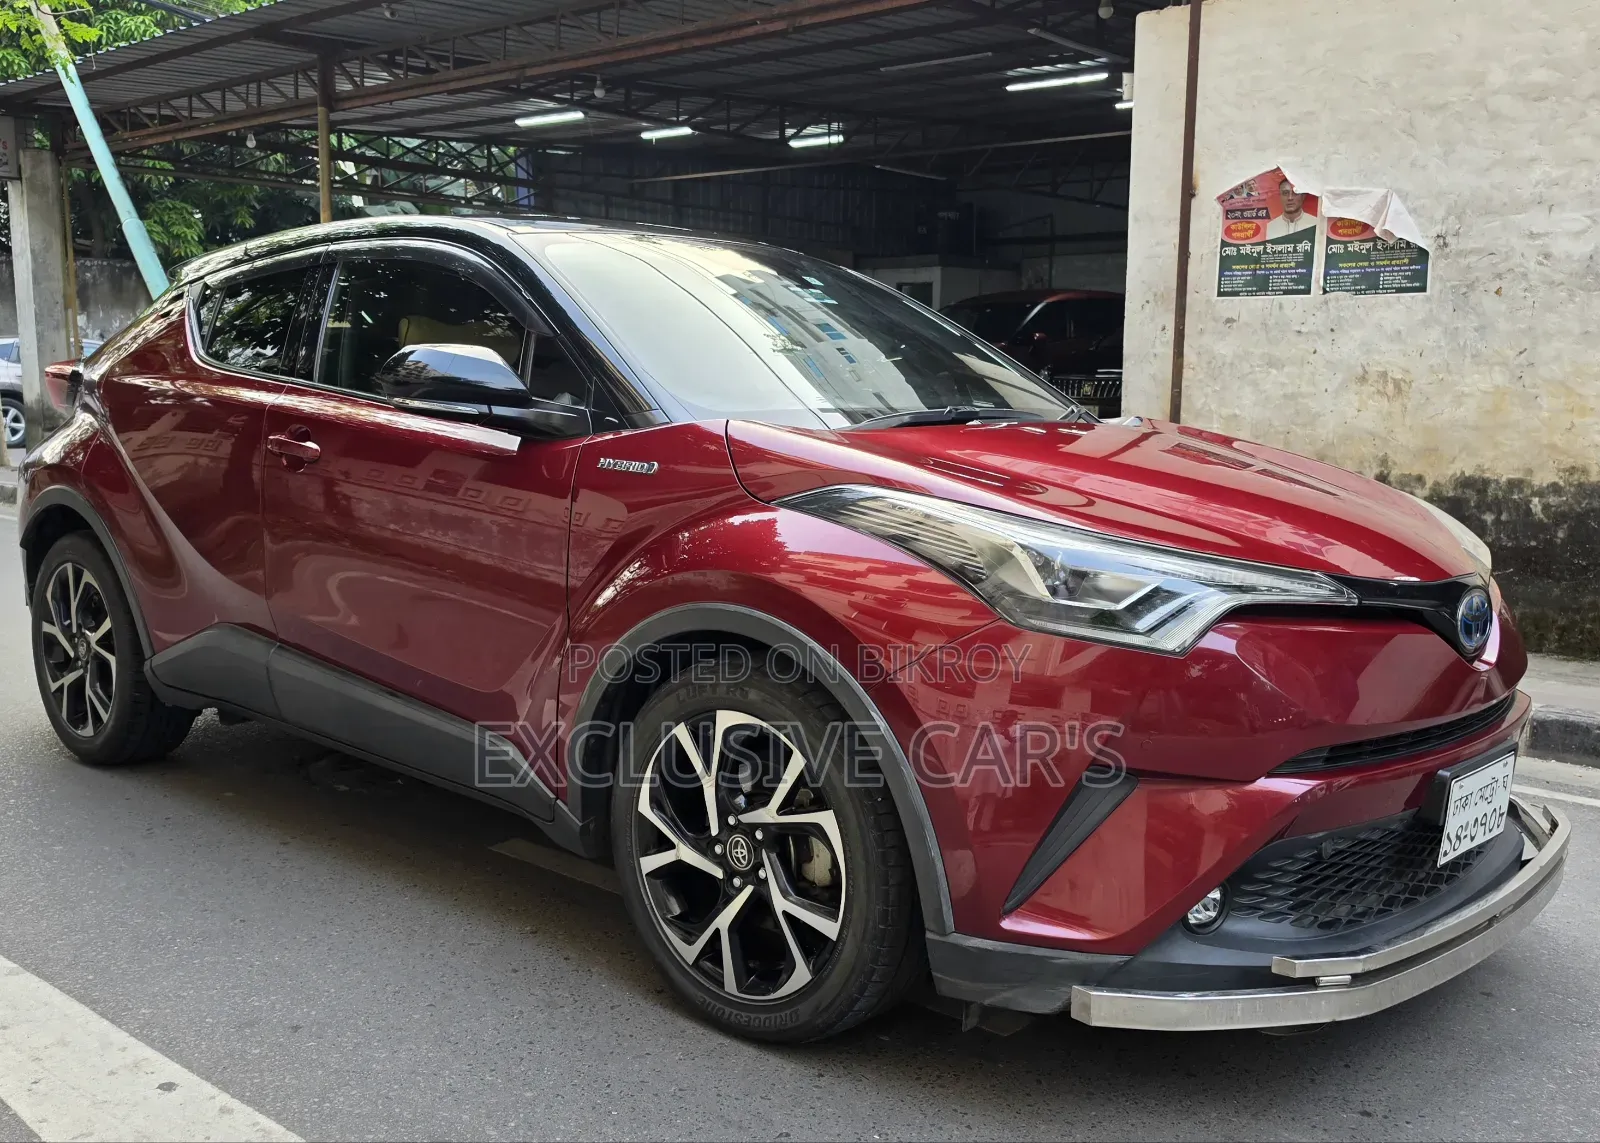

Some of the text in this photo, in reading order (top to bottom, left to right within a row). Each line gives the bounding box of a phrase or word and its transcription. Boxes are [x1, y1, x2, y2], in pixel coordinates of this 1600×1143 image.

[1222, 240, 1312, 257] মোঃ মইনুল ইসলাম রনি
[1328, 244, 1344, 254] মোঃ
[1347, 241, 1374, 254] মইনুল
[597, 457, 659, 474] HYBRID
[1453, 791, 1474, 816] ঢাকা
